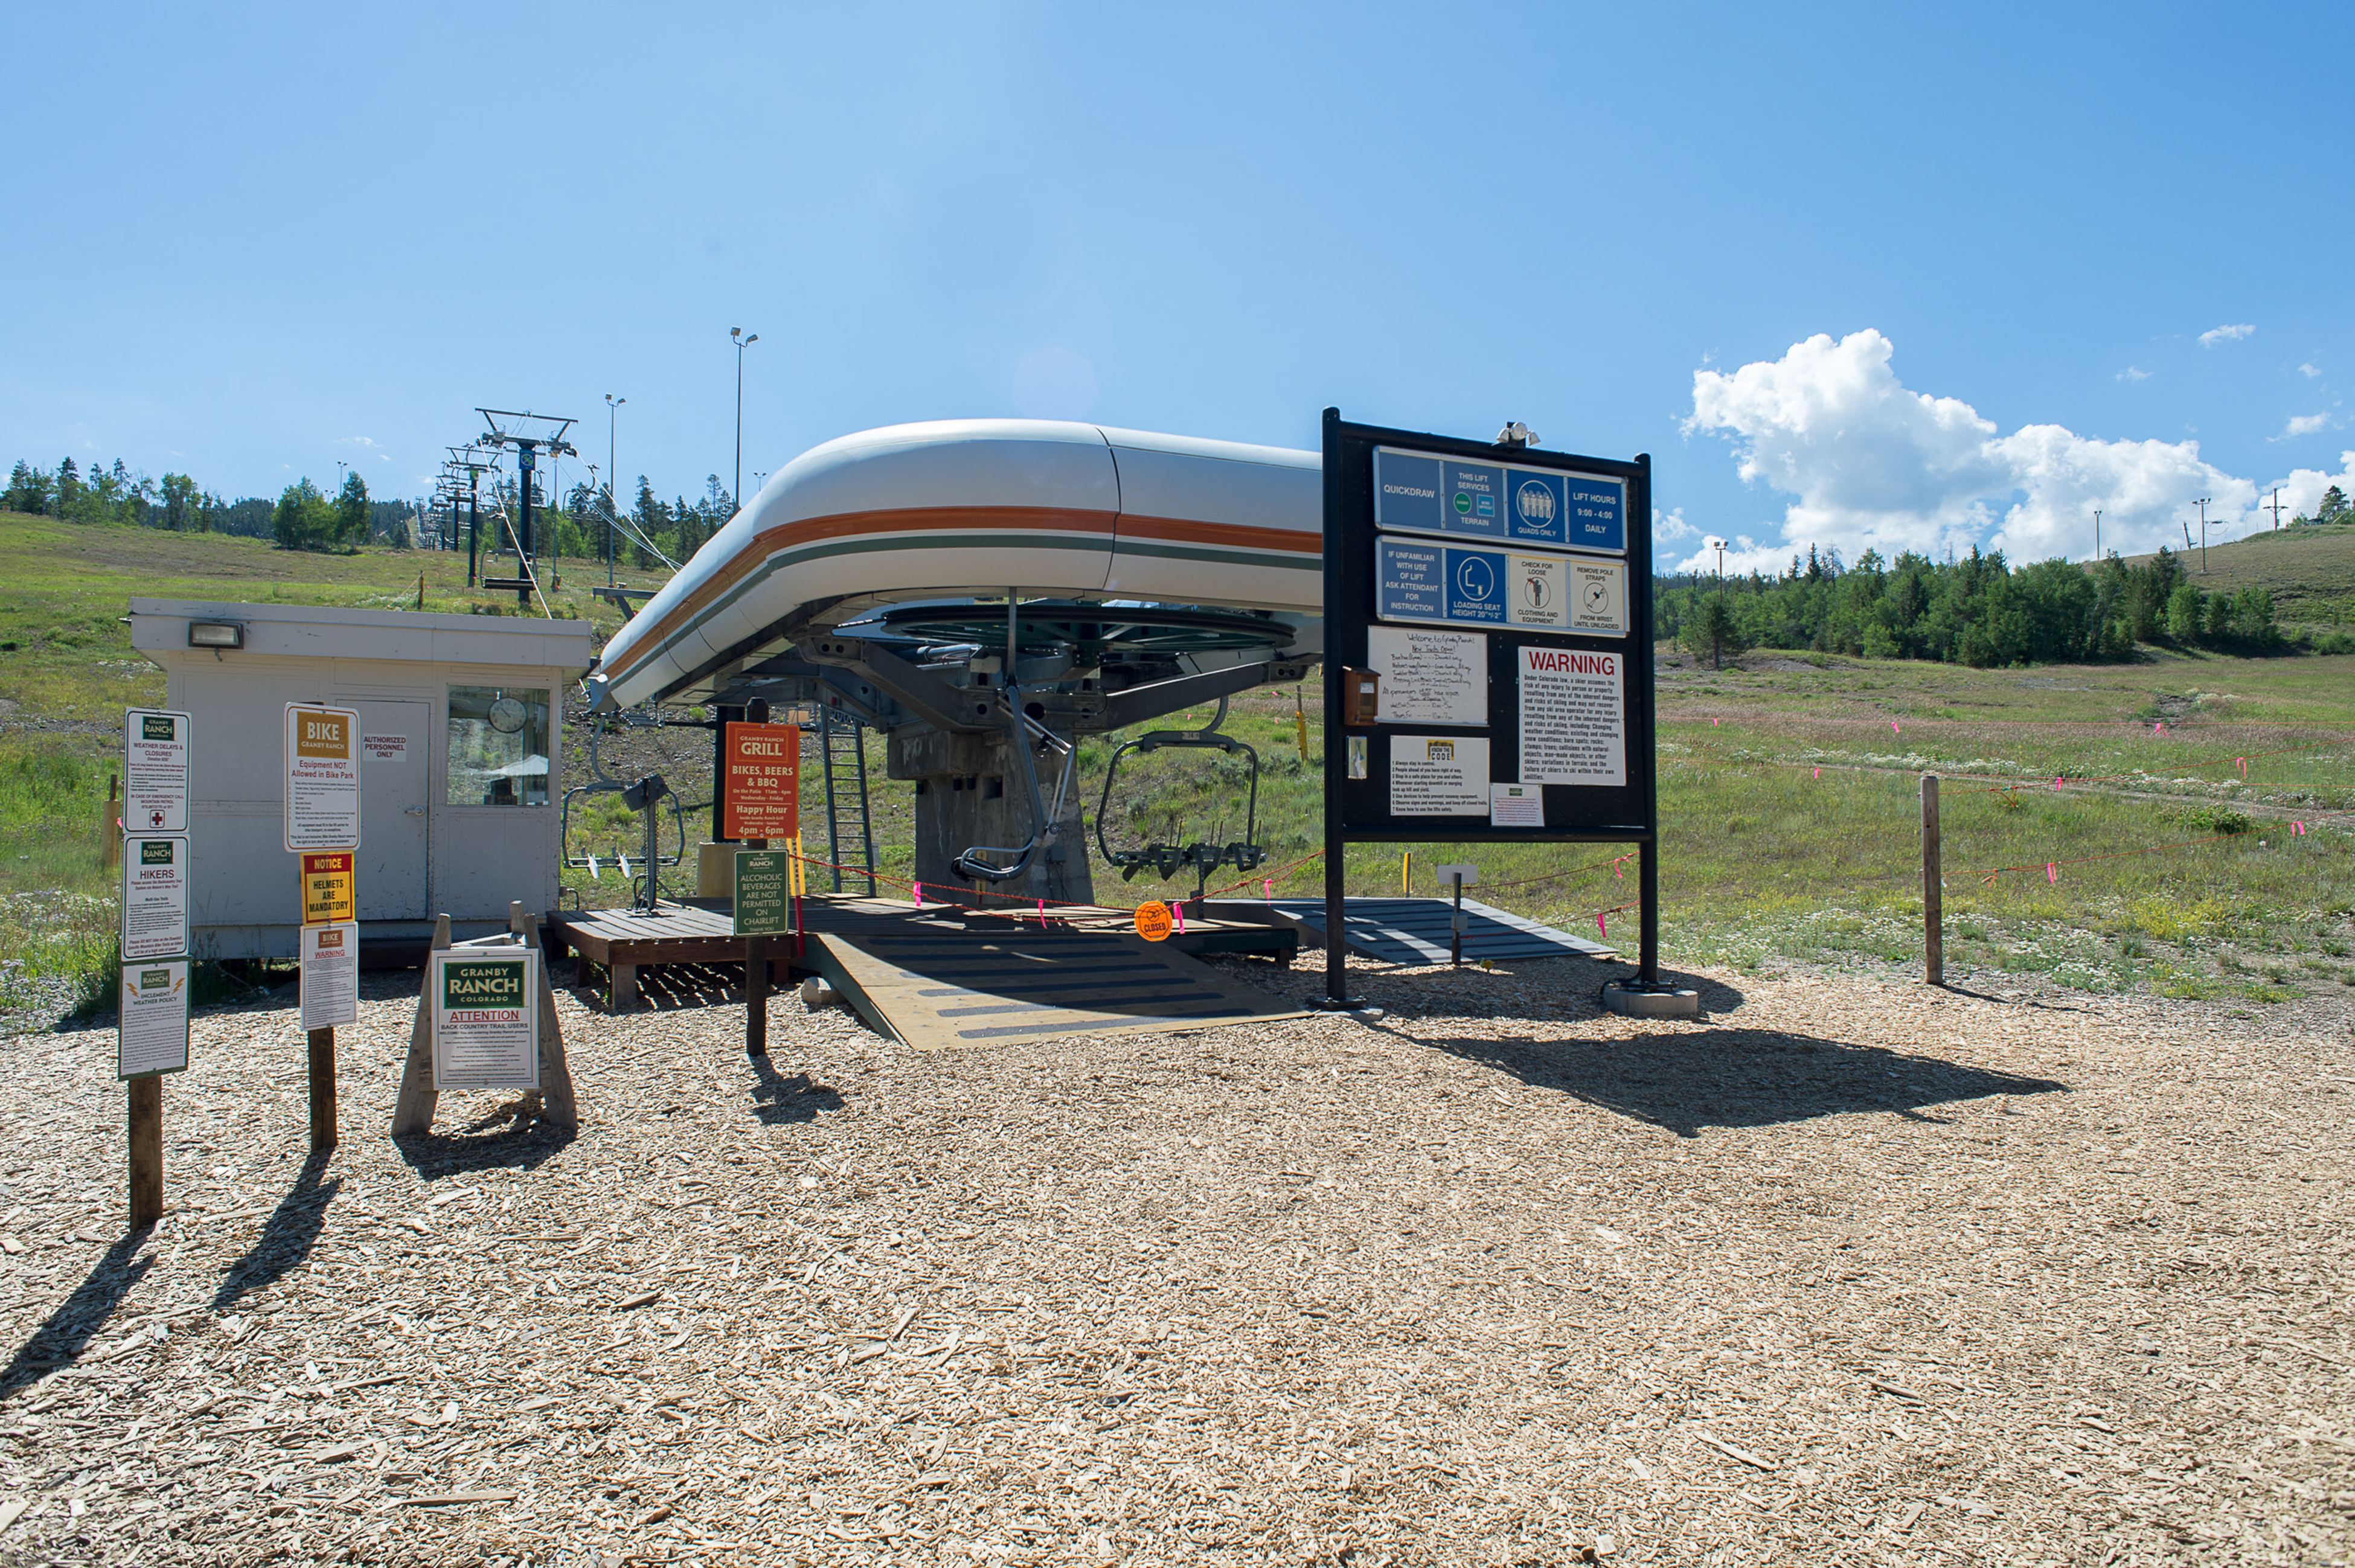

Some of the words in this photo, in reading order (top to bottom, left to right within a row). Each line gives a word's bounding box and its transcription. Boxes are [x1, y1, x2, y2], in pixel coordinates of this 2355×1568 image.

[1458, 472, 1473, 481] THIS
[1384, 485, 1435, 498] QUICKDRAW
[1458, 482, 1490, 492] SERVICES
[1573, 493, 1589, 501] LIFT
[1591, 494, 1616, 505] HOURS
[1577, 508, 1592, 517] 9:00
[1598, 511, 1613, 519] 4:00
[1461, 517, 1489, 526] TERRAIN
[1585, 525, 1606, 534] DAILY
[1395, 552, 1435, 562] UNFAMILIAR
[1400, 583, 1438, 592] ATTENDANT
[1391, 602, 1434, 612] INSTRUCTION
[1453, 601, 1483, 610] LOADING
[1406, 633, 1434, 643] Welcome
[1434, 634, 1442, 643] to
[1529, 651, 1615, 676] WARNING
[145, 725, 172, 734] RANCH
[307, 722, 339, 741] BIKE
[741, 741, 783, 756] GRILL
[300, 760, 332, 769] Equipment
[732, 766, 762, 775] BIKES,
[764, 766, 793, 775] BEERS
[747, 777, 754, 787] &
[757, 778, 778, 788] BBQ
[737, 805, 764, 815] Happy
[739, 827, 757, 836] 4pm
[765, 827, 784, 836] 6pm
[315, 858, 342, 869] NOTICE
[140, 869, 175, 879] HIKERS
[313, 879, 344, 889] HELMETS
[742, 882, 781, 891] BEVERAGES
[322, 891, 335, 900] ARE
[309, 901, 348, 912] MANDATORY
[742, 900, 781, 908] PERMITTED
[743, 917, 780, 925] CHAIRLIFT
[1144, 923, 1166, 932] CLOSED
[323, 933, 339, 942] BIKE
[315, 949, 345, 958] WARNING
[460, 968, 509, 977] GRANBY
[449, 978, 519, 994] RANCH
[450, 1010, 519, 1020] ATTENTION
